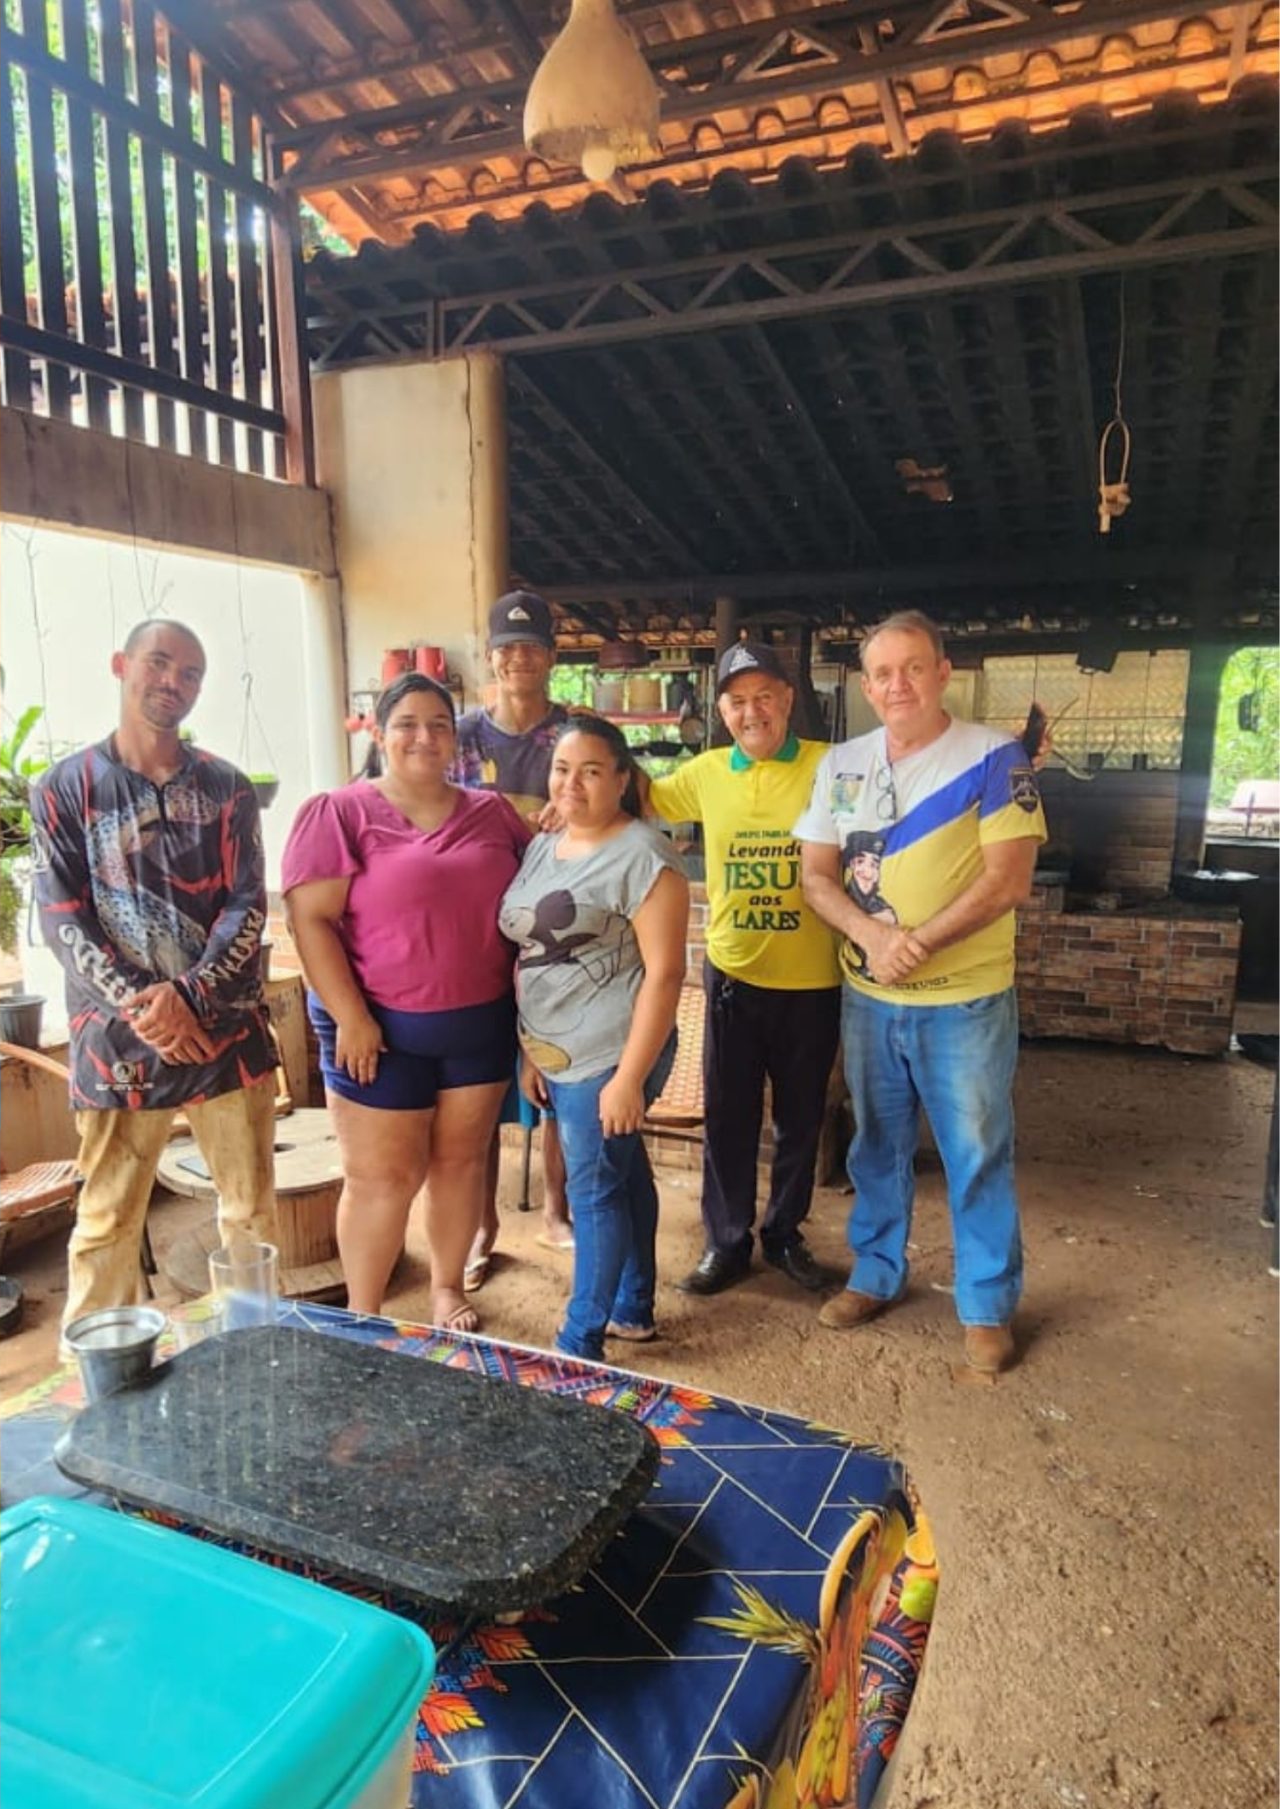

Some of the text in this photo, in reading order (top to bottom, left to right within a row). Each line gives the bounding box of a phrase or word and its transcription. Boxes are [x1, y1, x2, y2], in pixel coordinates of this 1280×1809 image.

[724, 861, 799, 896] JESU
[749, 895, 783, 906] aos
[733, 909, 801, 931] LARES
